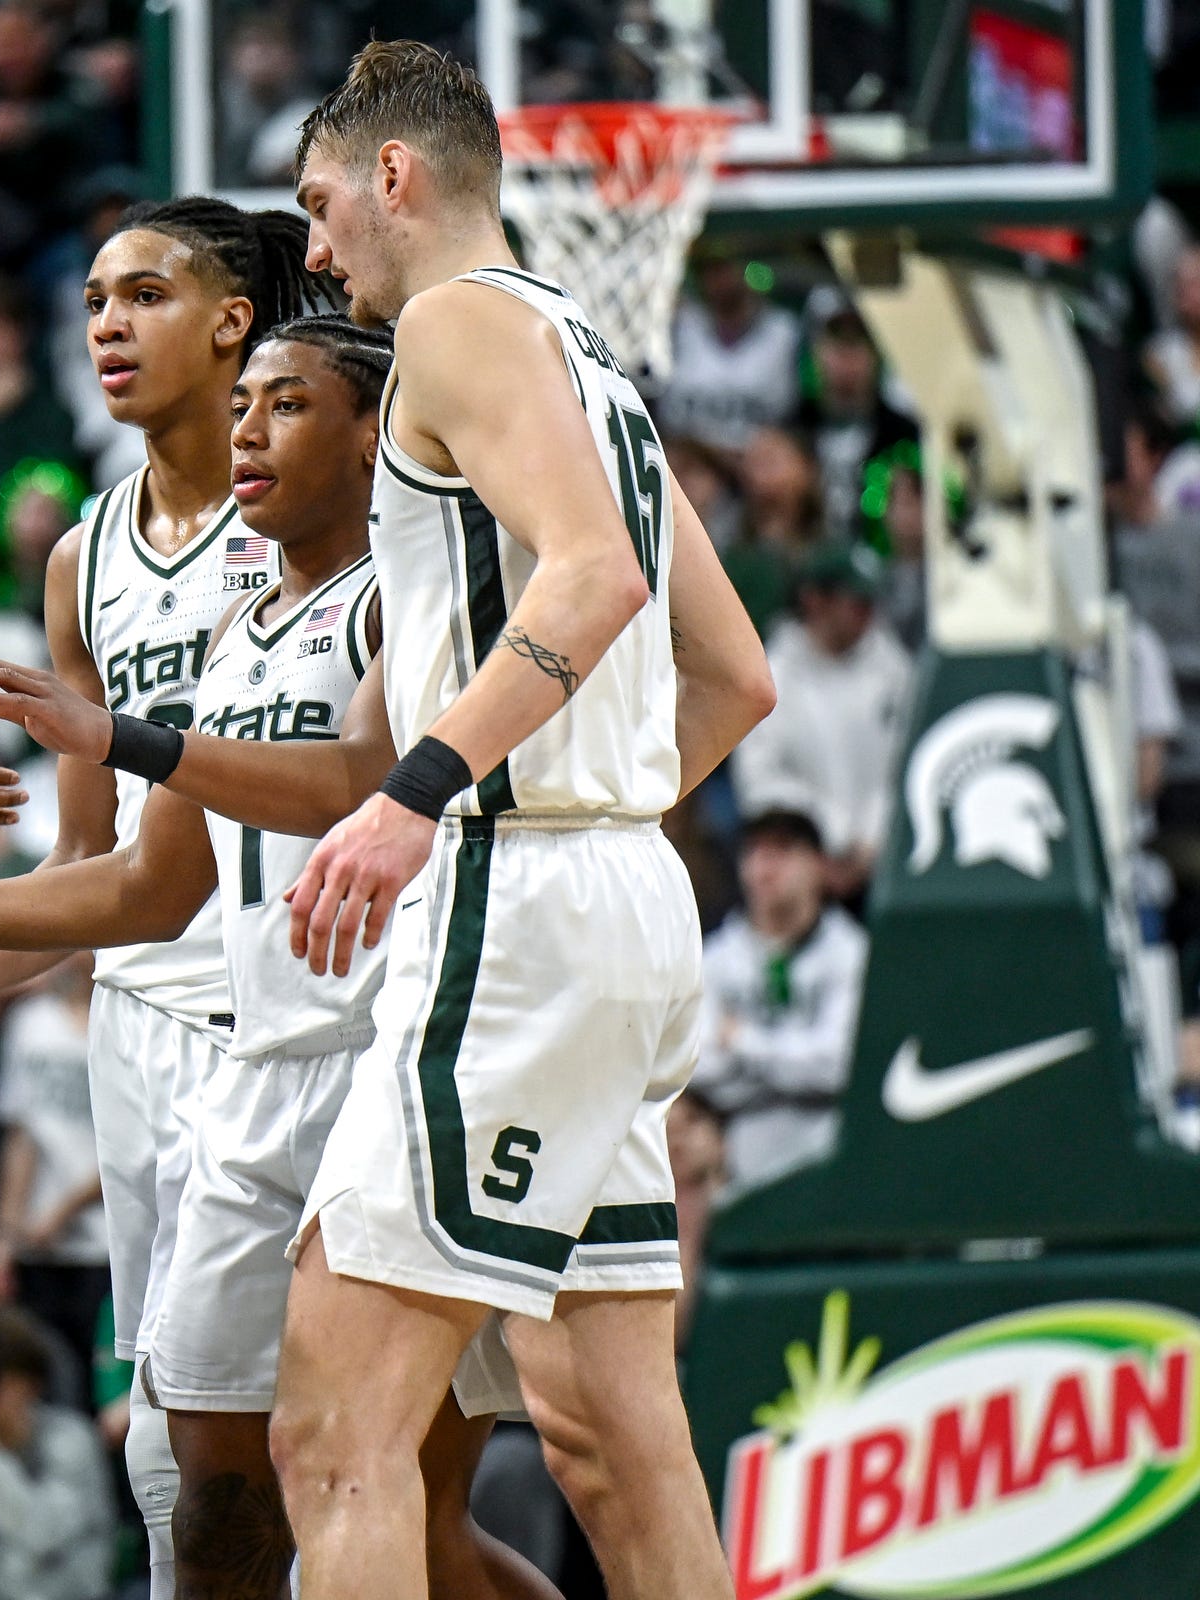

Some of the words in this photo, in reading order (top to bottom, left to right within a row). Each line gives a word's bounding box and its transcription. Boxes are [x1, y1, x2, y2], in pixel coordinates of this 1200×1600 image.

[606, 393, 662, 603] 15
[107, 627, 212, 714] Stat
[481, 1125, 542, 1204] S
[736, 1348, 1190, 1600] LIBMAN
